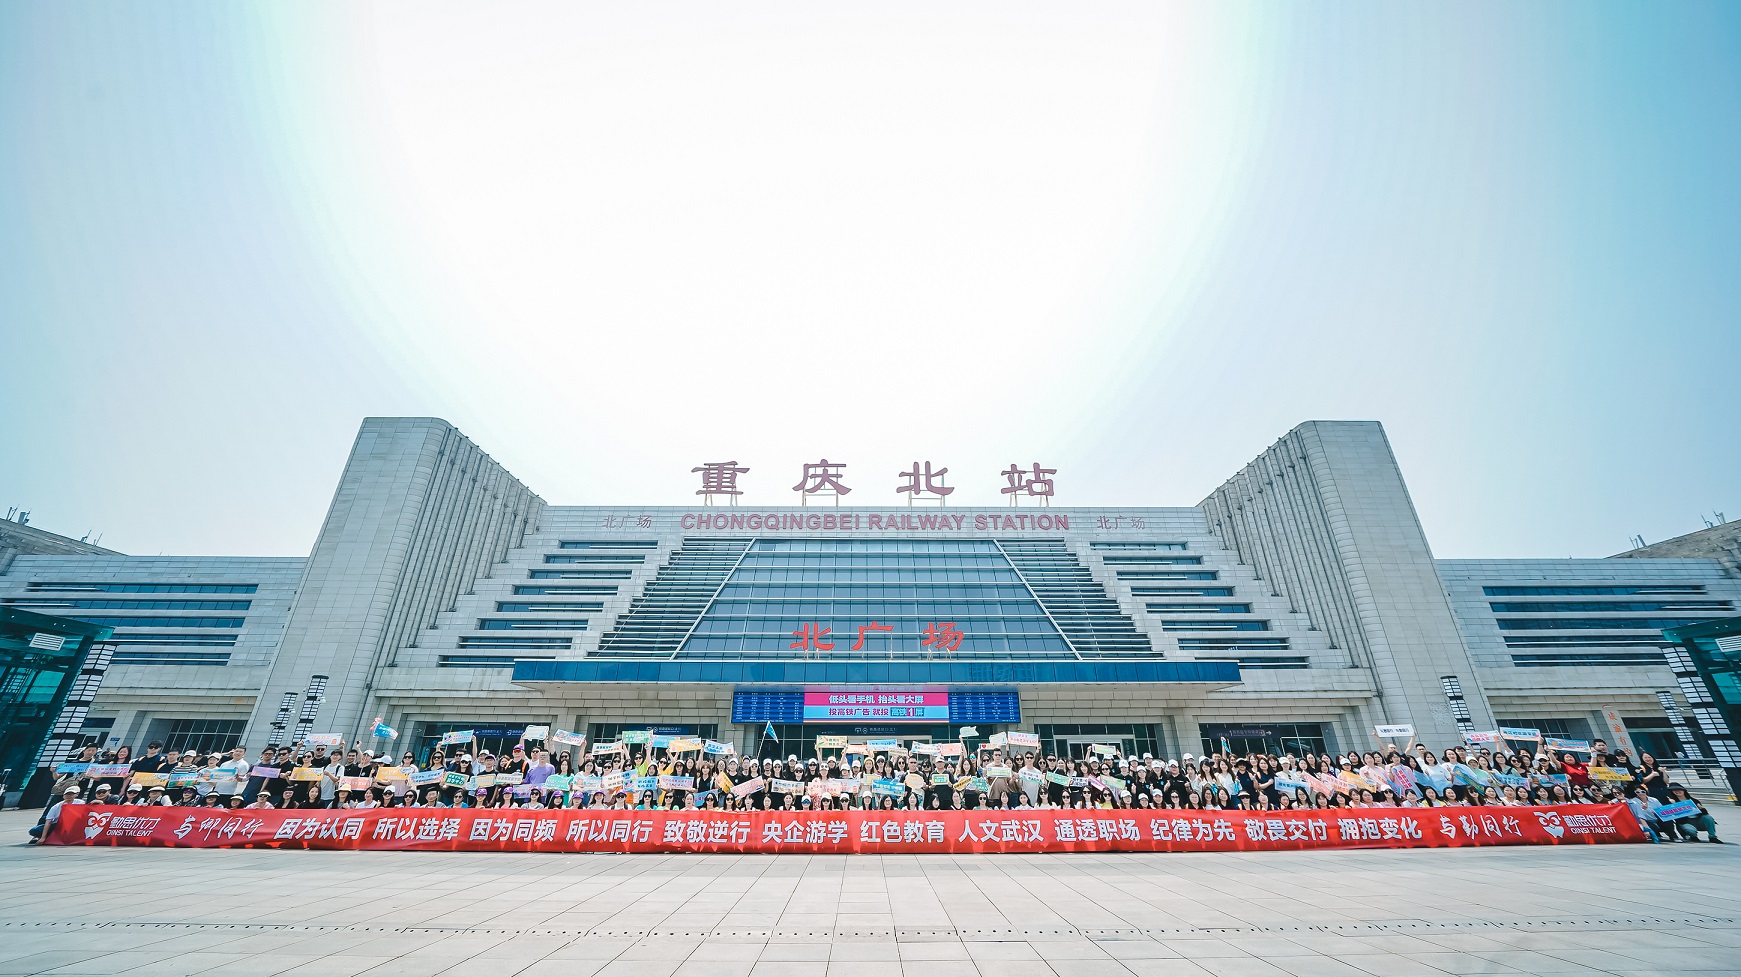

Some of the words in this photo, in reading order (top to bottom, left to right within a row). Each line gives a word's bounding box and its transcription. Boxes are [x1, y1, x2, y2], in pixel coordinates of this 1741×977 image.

[691, 459, 1057, 496] 重庆北站
[602, 514, 652, 528] 北广场
[681, 513, 860, 531] CHONGQINGBEI
[868, 514, 965, 531] RAILWAY
[975, 514, 1069, 531] STATION
[1097, 515, 1145, 529] 北广场
[790, 622, 964, 650] 北广场
[828, 695, 875, 704] 低头看手机
[878, 695, 924, 704] 抬头看大屏
[828, 708, 870, 716] 投高铁广告
[274, 818, 365, 841] 因为认同
[373, 817, 461, 841] 所以选择
[469, 818, 558, 842] 因为同频
[566, 819, 653, 842] 所以同行
[663, 820, 751, 844] 致敬逆行
[762, 820, 848, 844] 央企游学
[860, 820, 945, 843] 红色教育
[959, 820, 1044, 843] 人文武汉
[1054, 819, 1141, 842] 通透职场
[1150, 819, 1235, 842] 纪律为先
[1244, 818, 1328, 841] 敬畏交付
[1338, 817, 1422, 840] 拥抱变化
